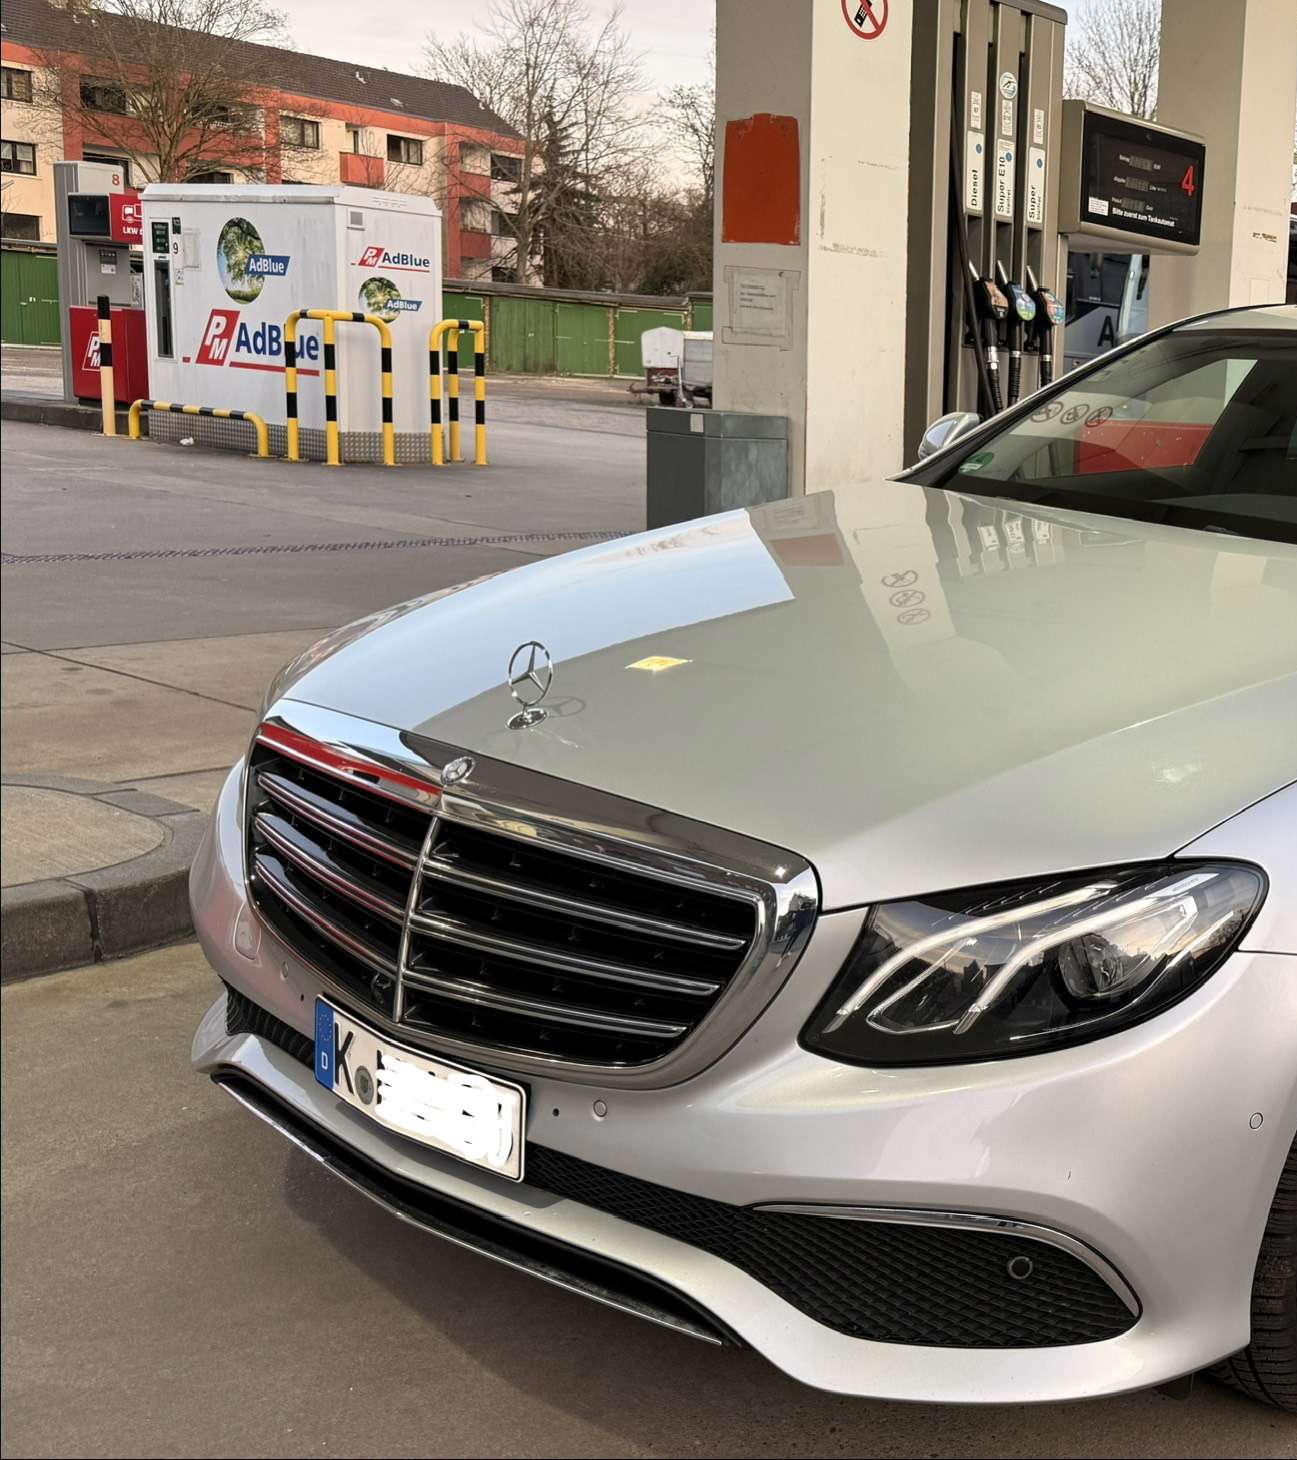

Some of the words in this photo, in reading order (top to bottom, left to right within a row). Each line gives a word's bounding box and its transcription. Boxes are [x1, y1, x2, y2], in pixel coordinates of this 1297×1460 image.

[998, 156, 1006, 177] E10
[112, 174, 120, 186] 8
[1181, 165, 1195, 197] 4
[997, 178, 1006, 213] Super
[123, 226, 138, 236] LKW
[173, 242, 179, 254] 9
[249, 257, 285, 274] AdBlue
[382, 252, 430, 268] AdBlue
[386, 300, 418, 310] AdBlue
[235, 322, 320, 361] AdBue
[321, 1051, 328, 1070] D
[334, 1021, 355, 1095] K
